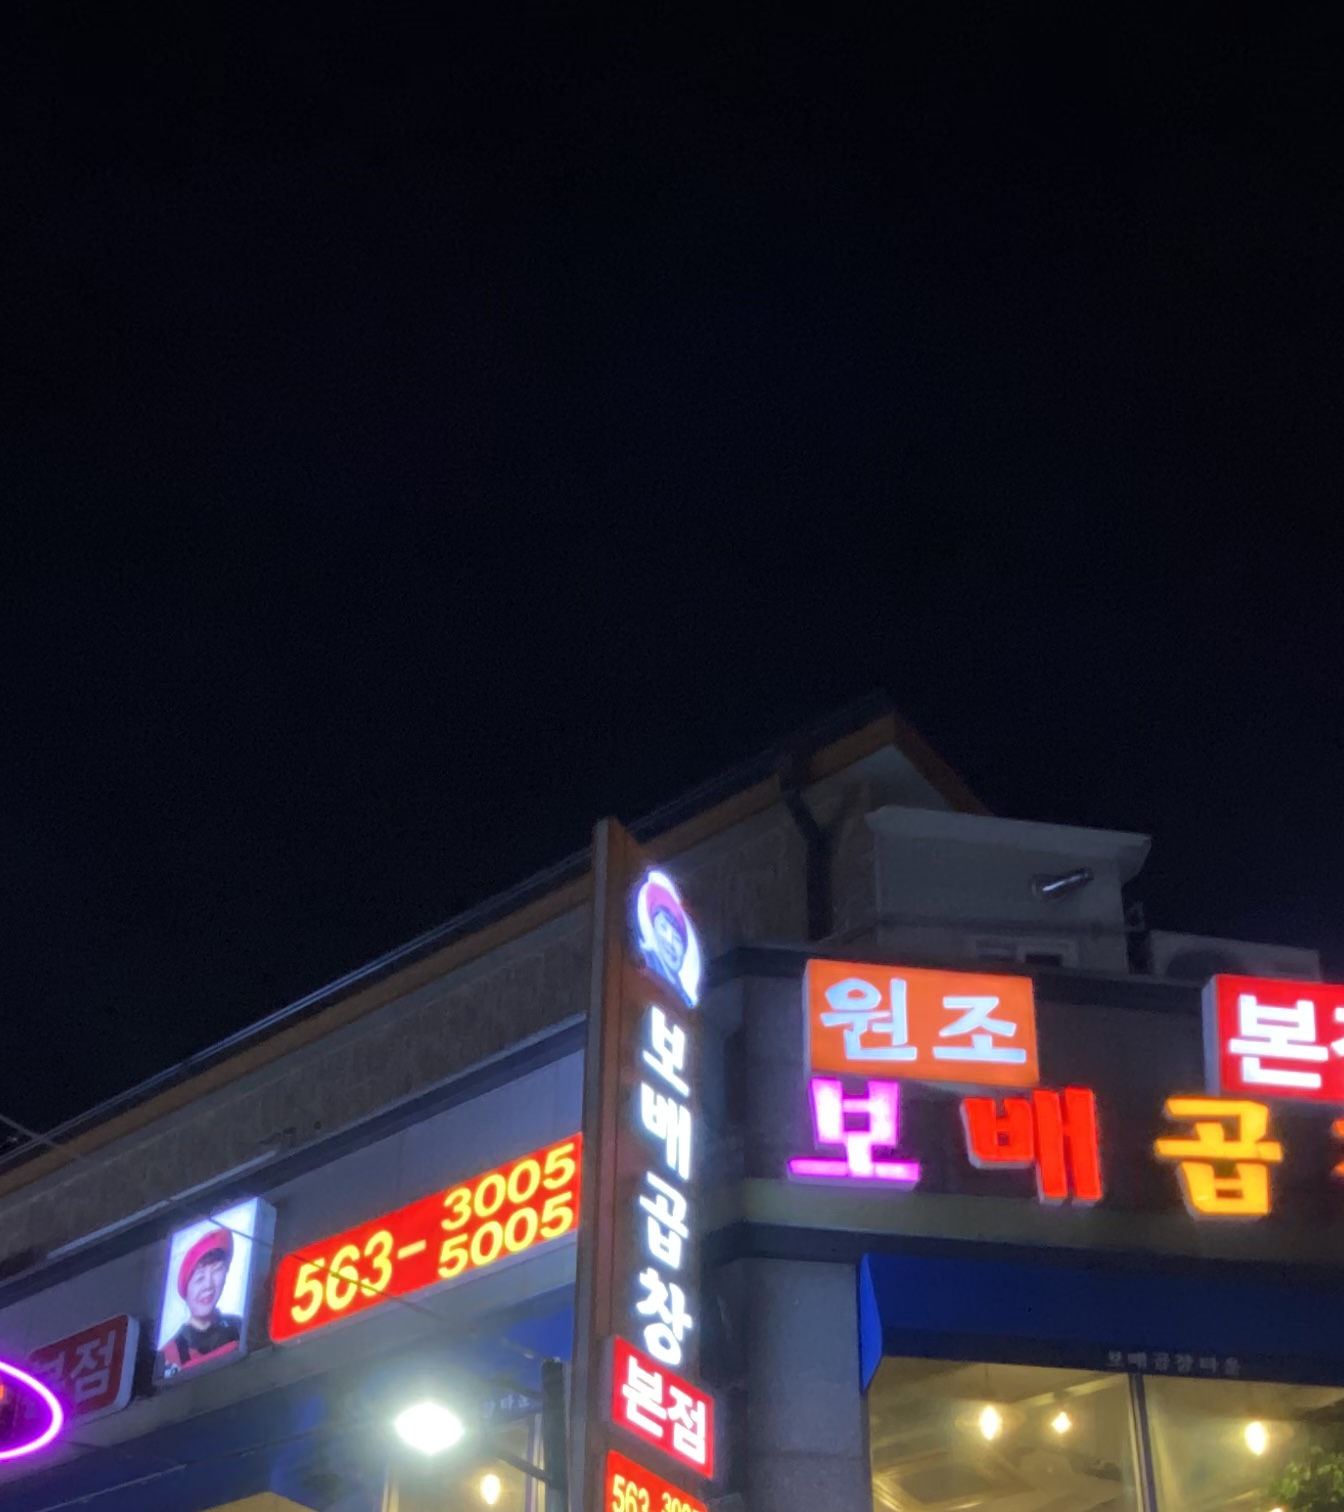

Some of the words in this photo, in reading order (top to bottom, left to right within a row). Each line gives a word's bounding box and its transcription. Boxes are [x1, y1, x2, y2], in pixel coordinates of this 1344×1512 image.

[818, 977, 1028, 1064] 원조
[637, 1003, 694, 1367] 보배곱창
[436, 1191, 574, 1281] 5005
[622, 1355, 706, 1465] 본점
